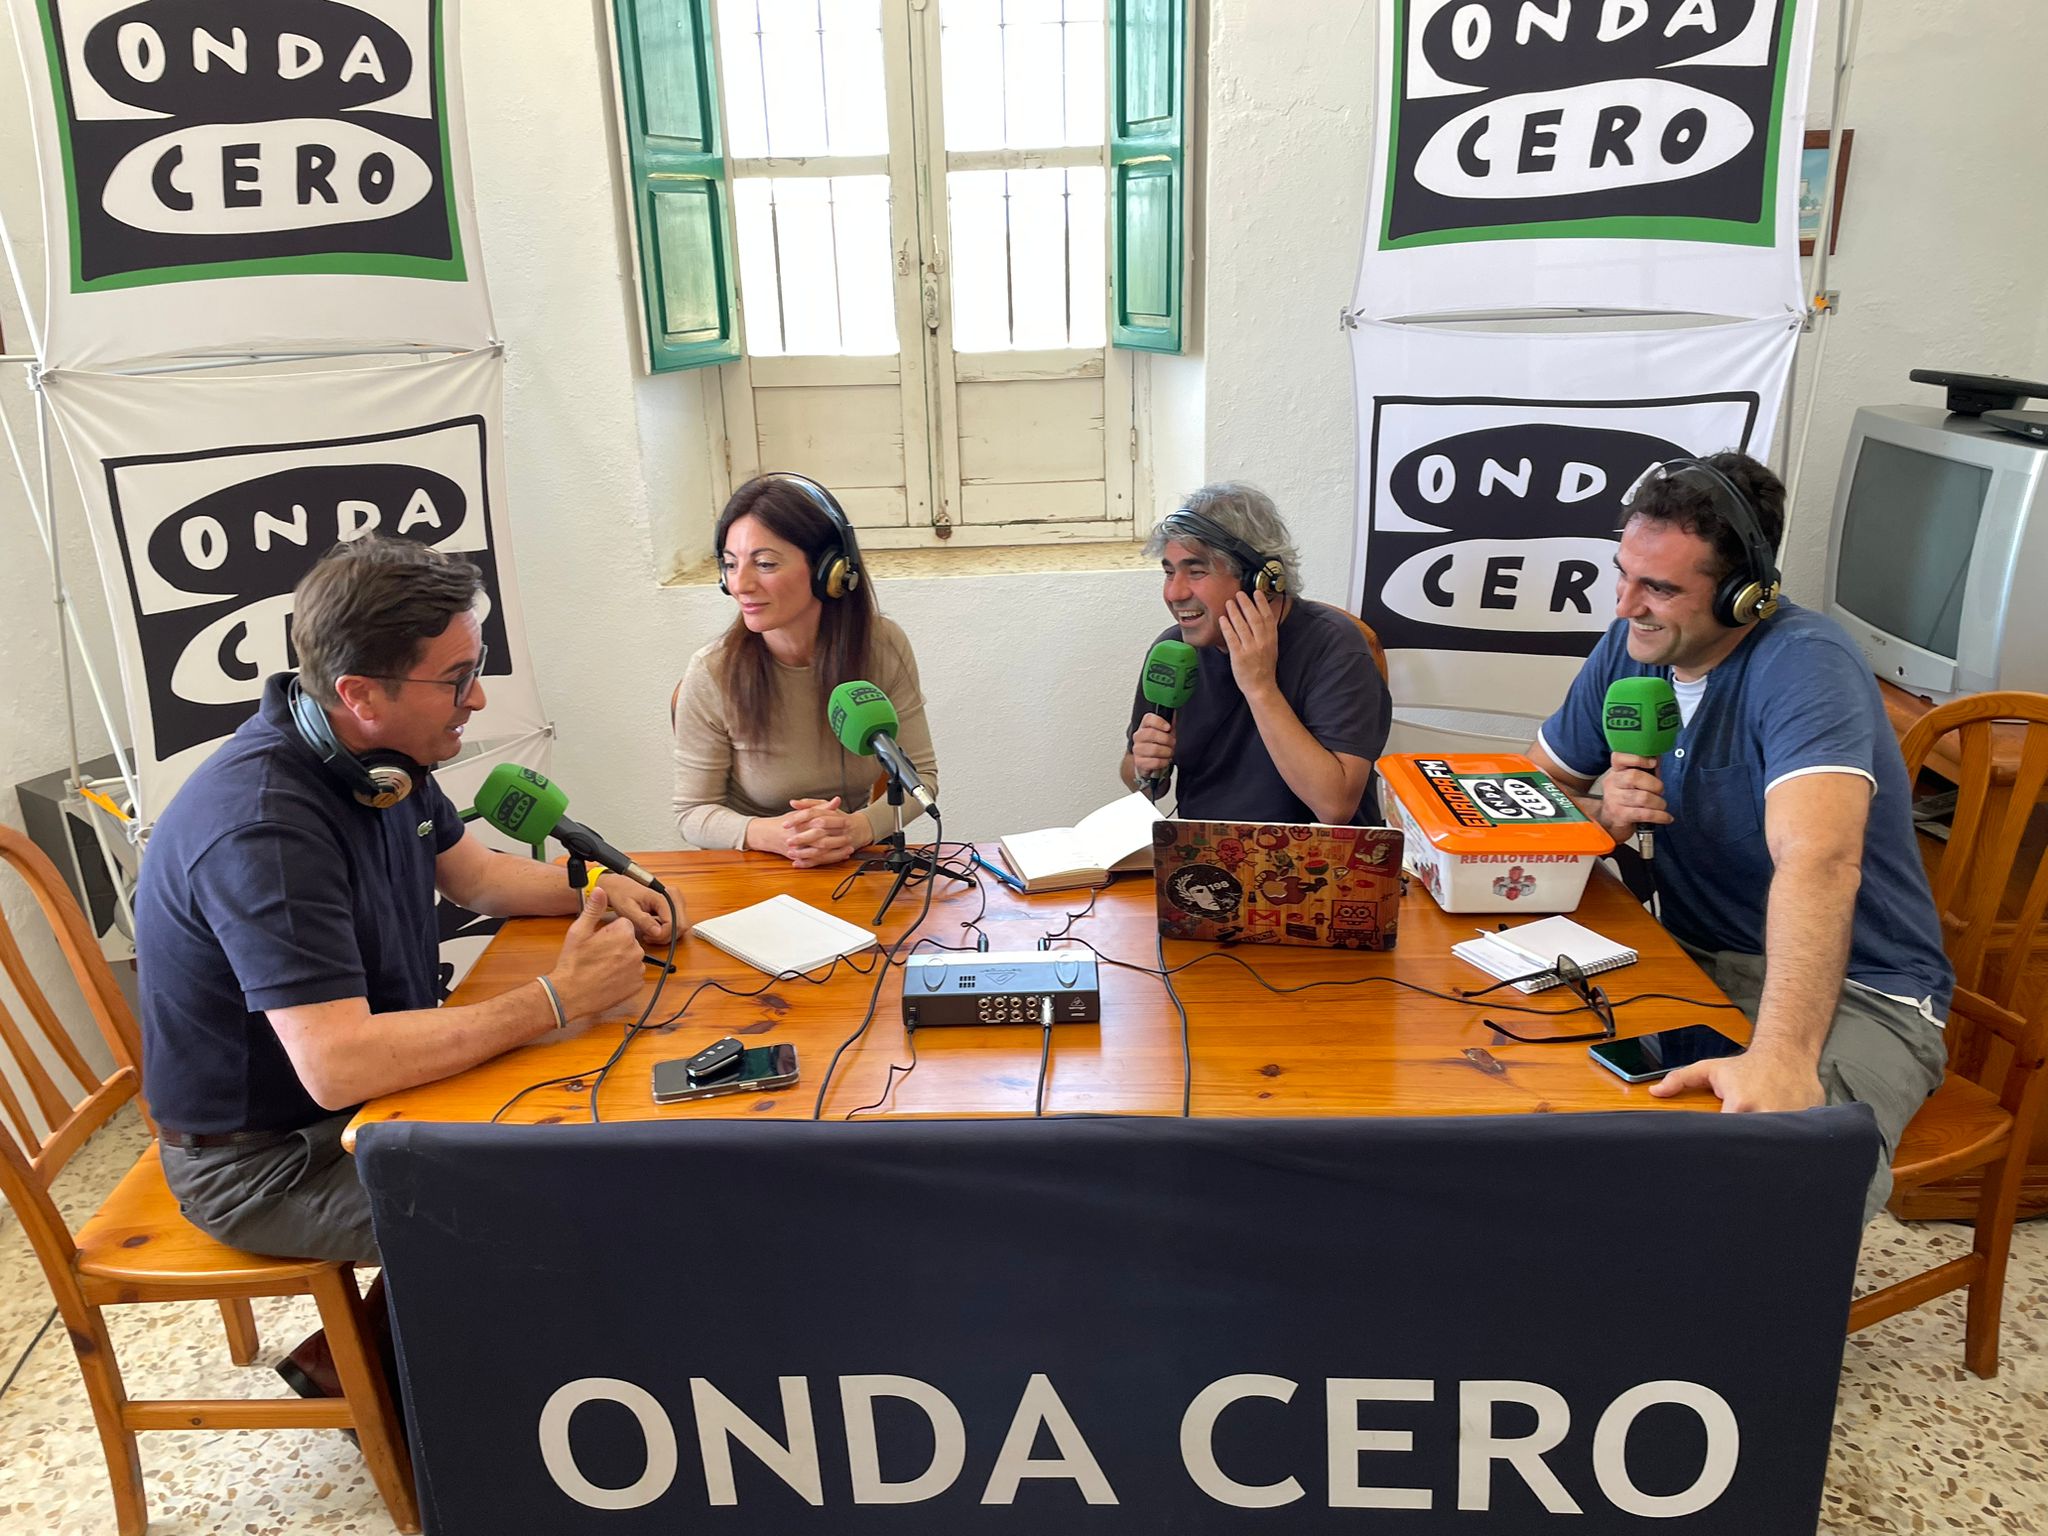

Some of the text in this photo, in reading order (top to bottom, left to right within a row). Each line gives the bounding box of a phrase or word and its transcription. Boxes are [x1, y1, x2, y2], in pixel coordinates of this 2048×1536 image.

[117, 21, 386, 83] ONDA
[1452, 0, 1717, 60] ONDA
[1457, 104, 1707, 177] CERO
[152, 143, 394, 211] CERO
[180, 488, 441, 570] ONDA
[1422, 554, 1599, 614] CER
[1478, 785, 1517, 815] ONDA
[1510, 783, 1547, 811] CERO
[1460, 855, 1579, 864] REGALOTERAPIA
[539, 1374, 1740, 1518] ONDA CERO
